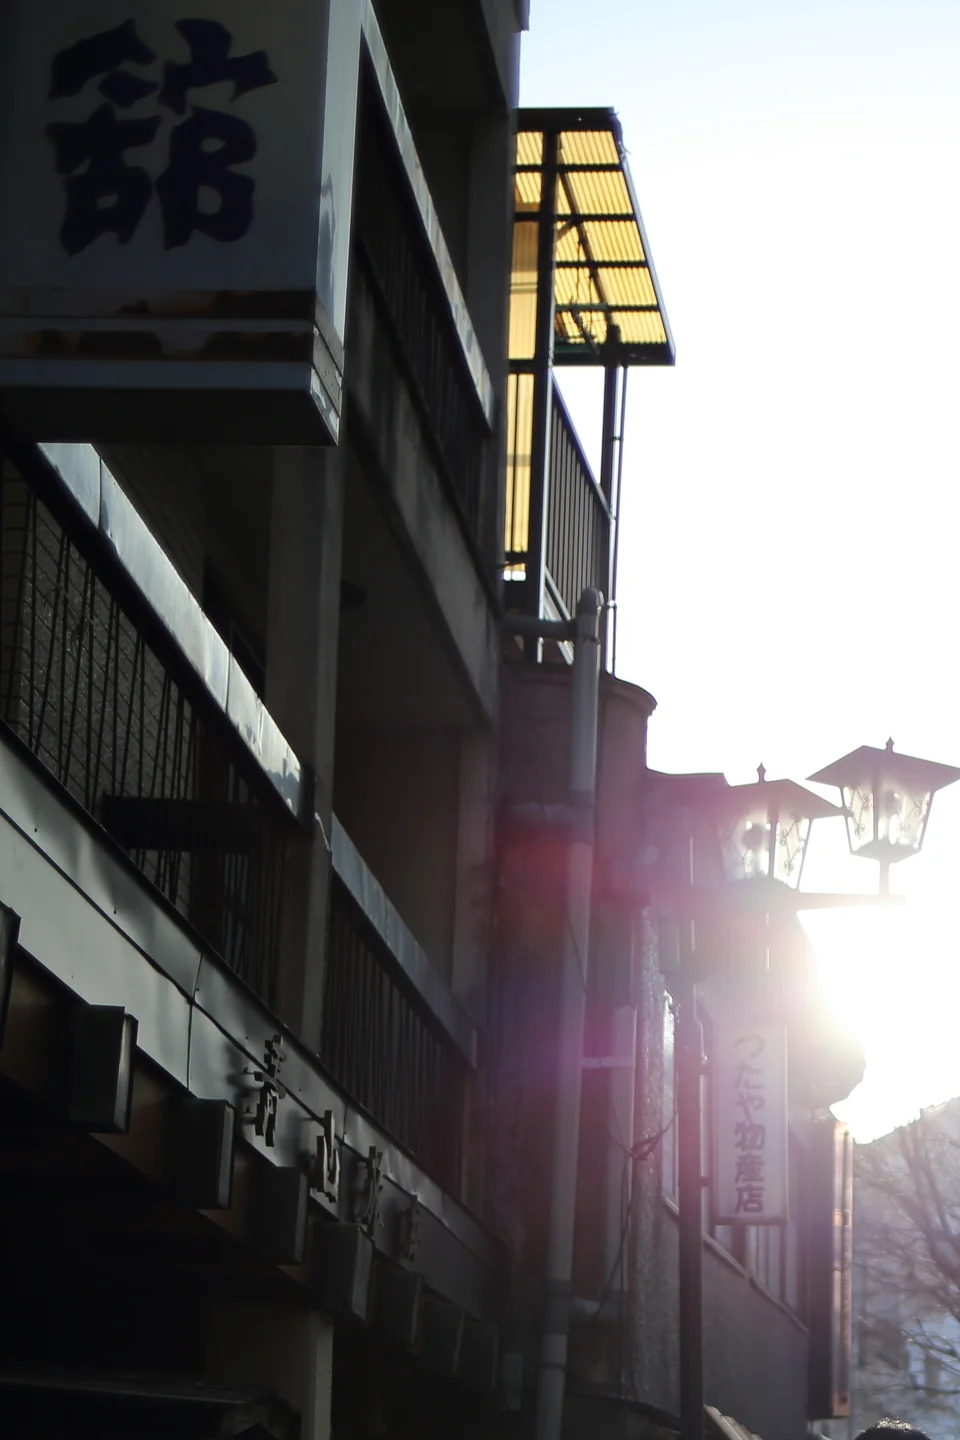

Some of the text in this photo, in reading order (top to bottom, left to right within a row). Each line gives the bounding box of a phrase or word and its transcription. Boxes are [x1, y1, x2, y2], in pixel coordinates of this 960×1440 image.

[733, 1033, 767, 1214] つたや物産店
